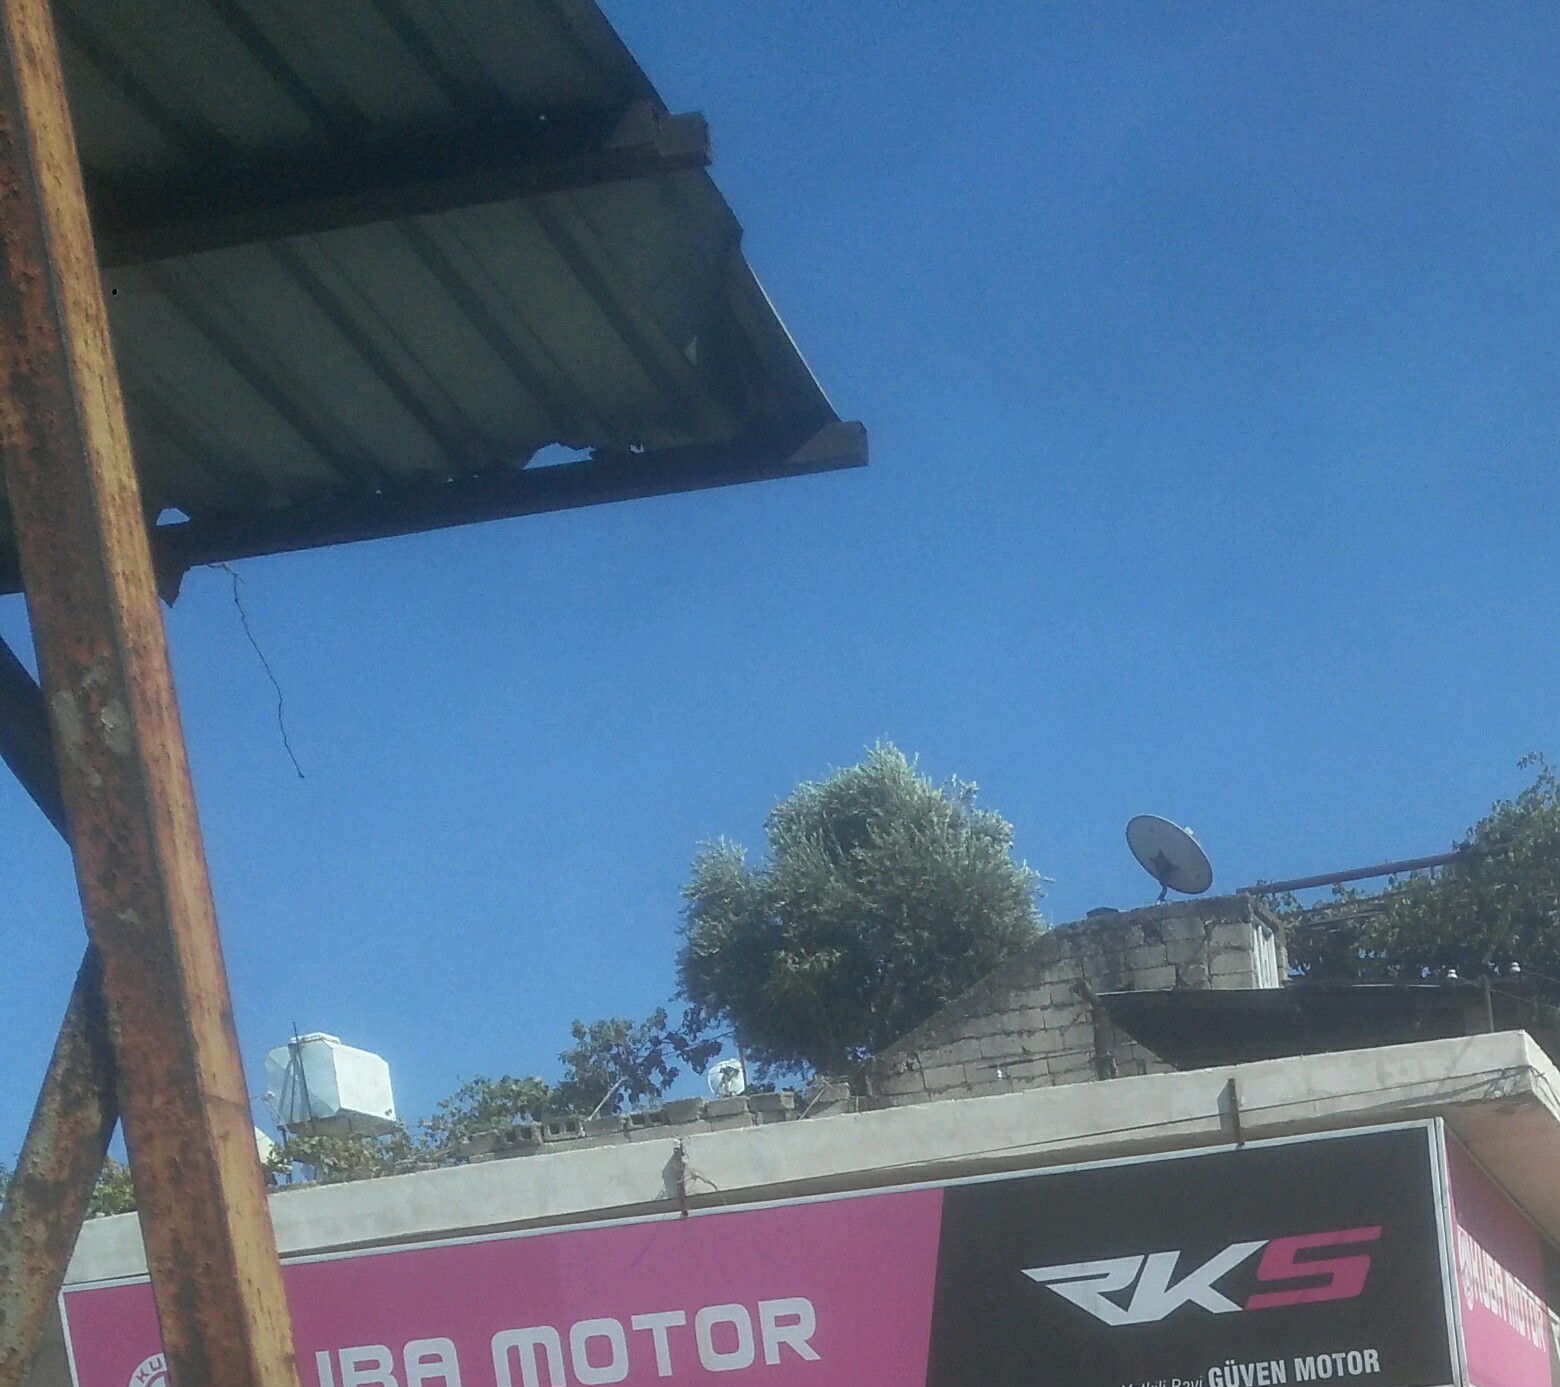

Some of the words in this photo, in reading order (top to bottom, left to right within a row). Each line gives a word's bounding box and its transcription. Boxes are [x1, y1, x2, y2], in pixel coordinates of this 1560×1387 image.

[1021, 1226, 1382, 1326] RKS
[136, 1357, 163, 1384] KU
[1294, 1349, 1380, 1382] MOTOR
